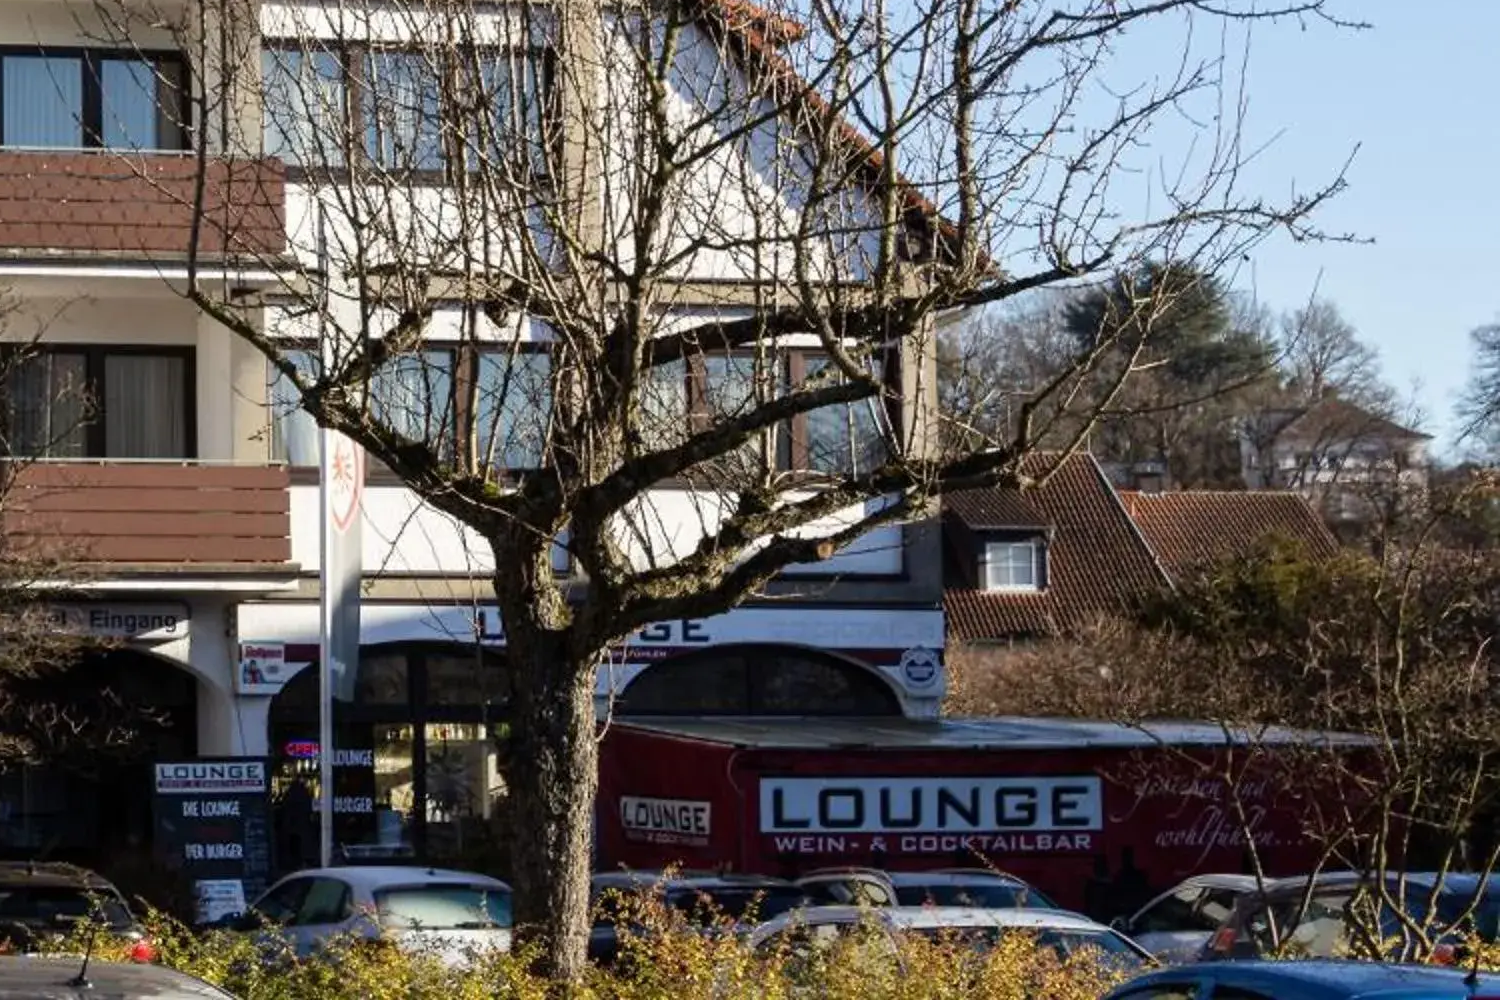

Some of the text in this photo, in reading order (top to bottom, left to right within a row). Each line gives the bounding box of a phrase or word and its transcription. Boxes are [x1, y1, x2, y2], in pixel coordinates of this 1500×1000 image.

[89, 610, 178, 633] Eingang
[161, 765, 259, 779] LOUNGE
[623, 802, 706, 832] LOUNGE
[773, 787, 1090, 829] LOUNGE
[869, 836, 888, 852] &
[901, 835, 1092, 852] COCKTAILBAR
